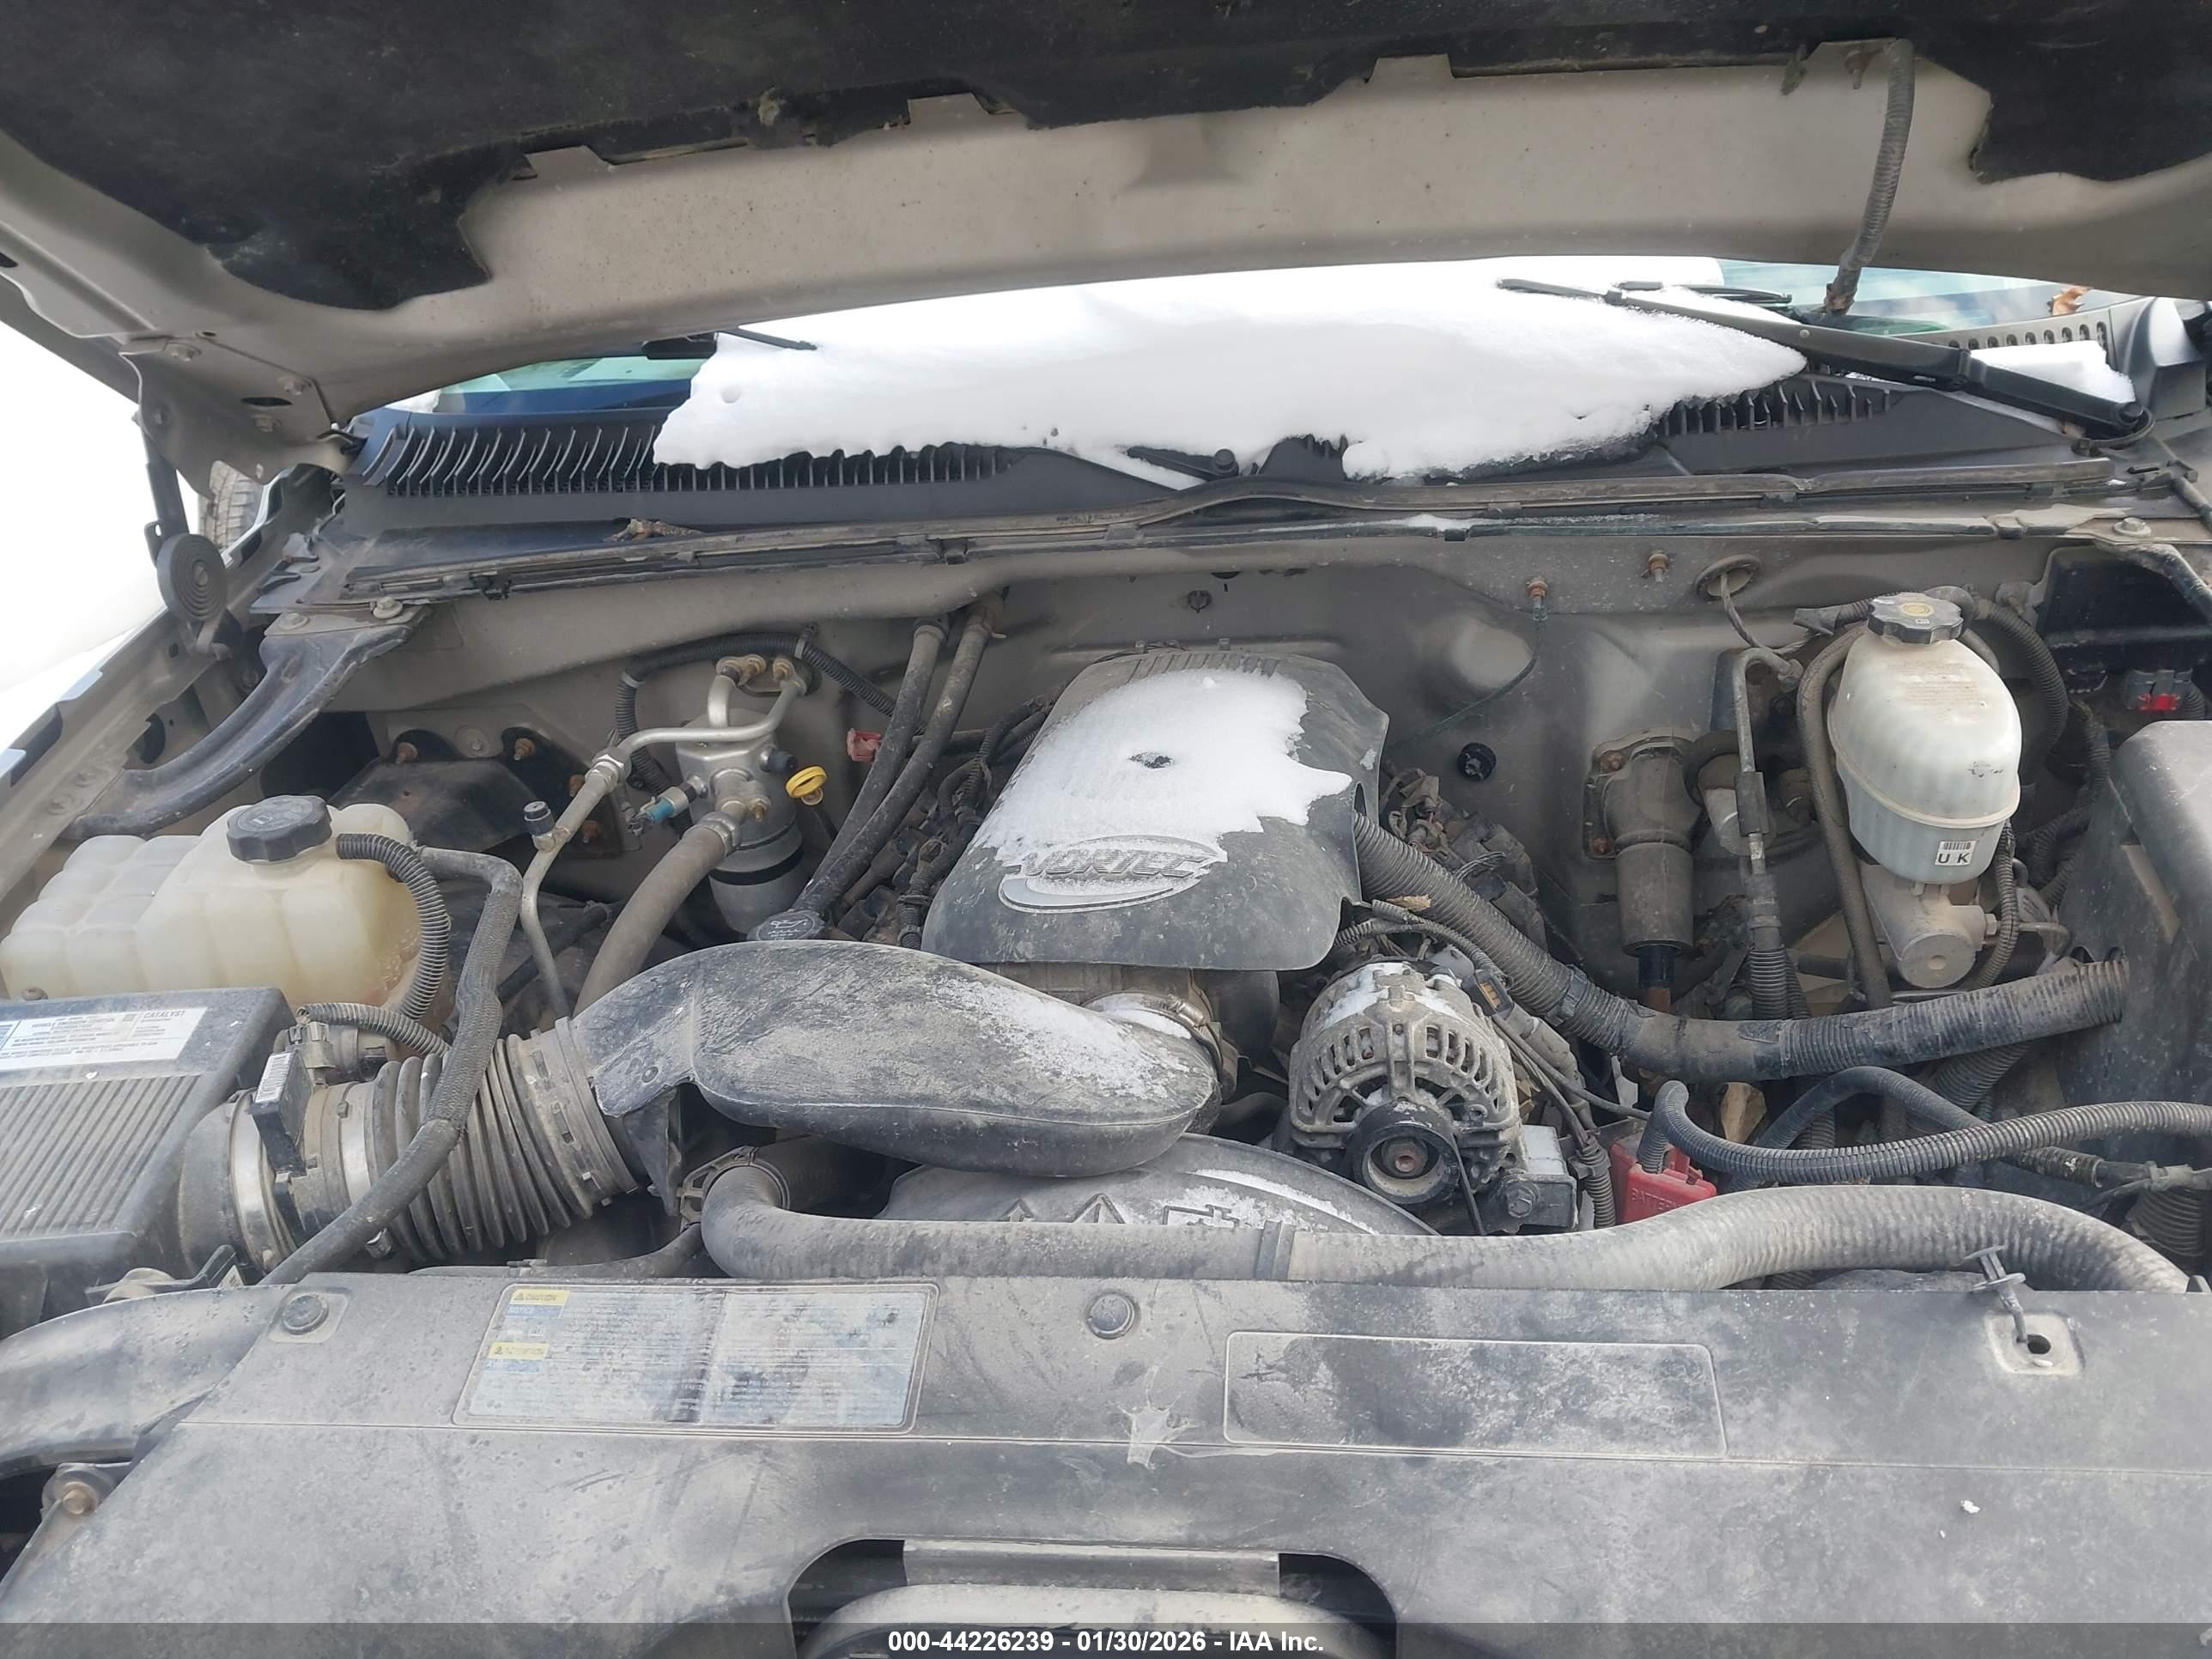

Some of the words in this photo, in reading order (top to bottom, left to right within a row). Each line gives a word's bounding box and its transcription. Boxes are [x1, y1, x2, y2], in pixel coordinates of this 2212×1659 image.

[1938, 853, 1950, 864] U
[1957, 852, 1970, 864] K
[143, 1010, 186, 1018] CATALYST
